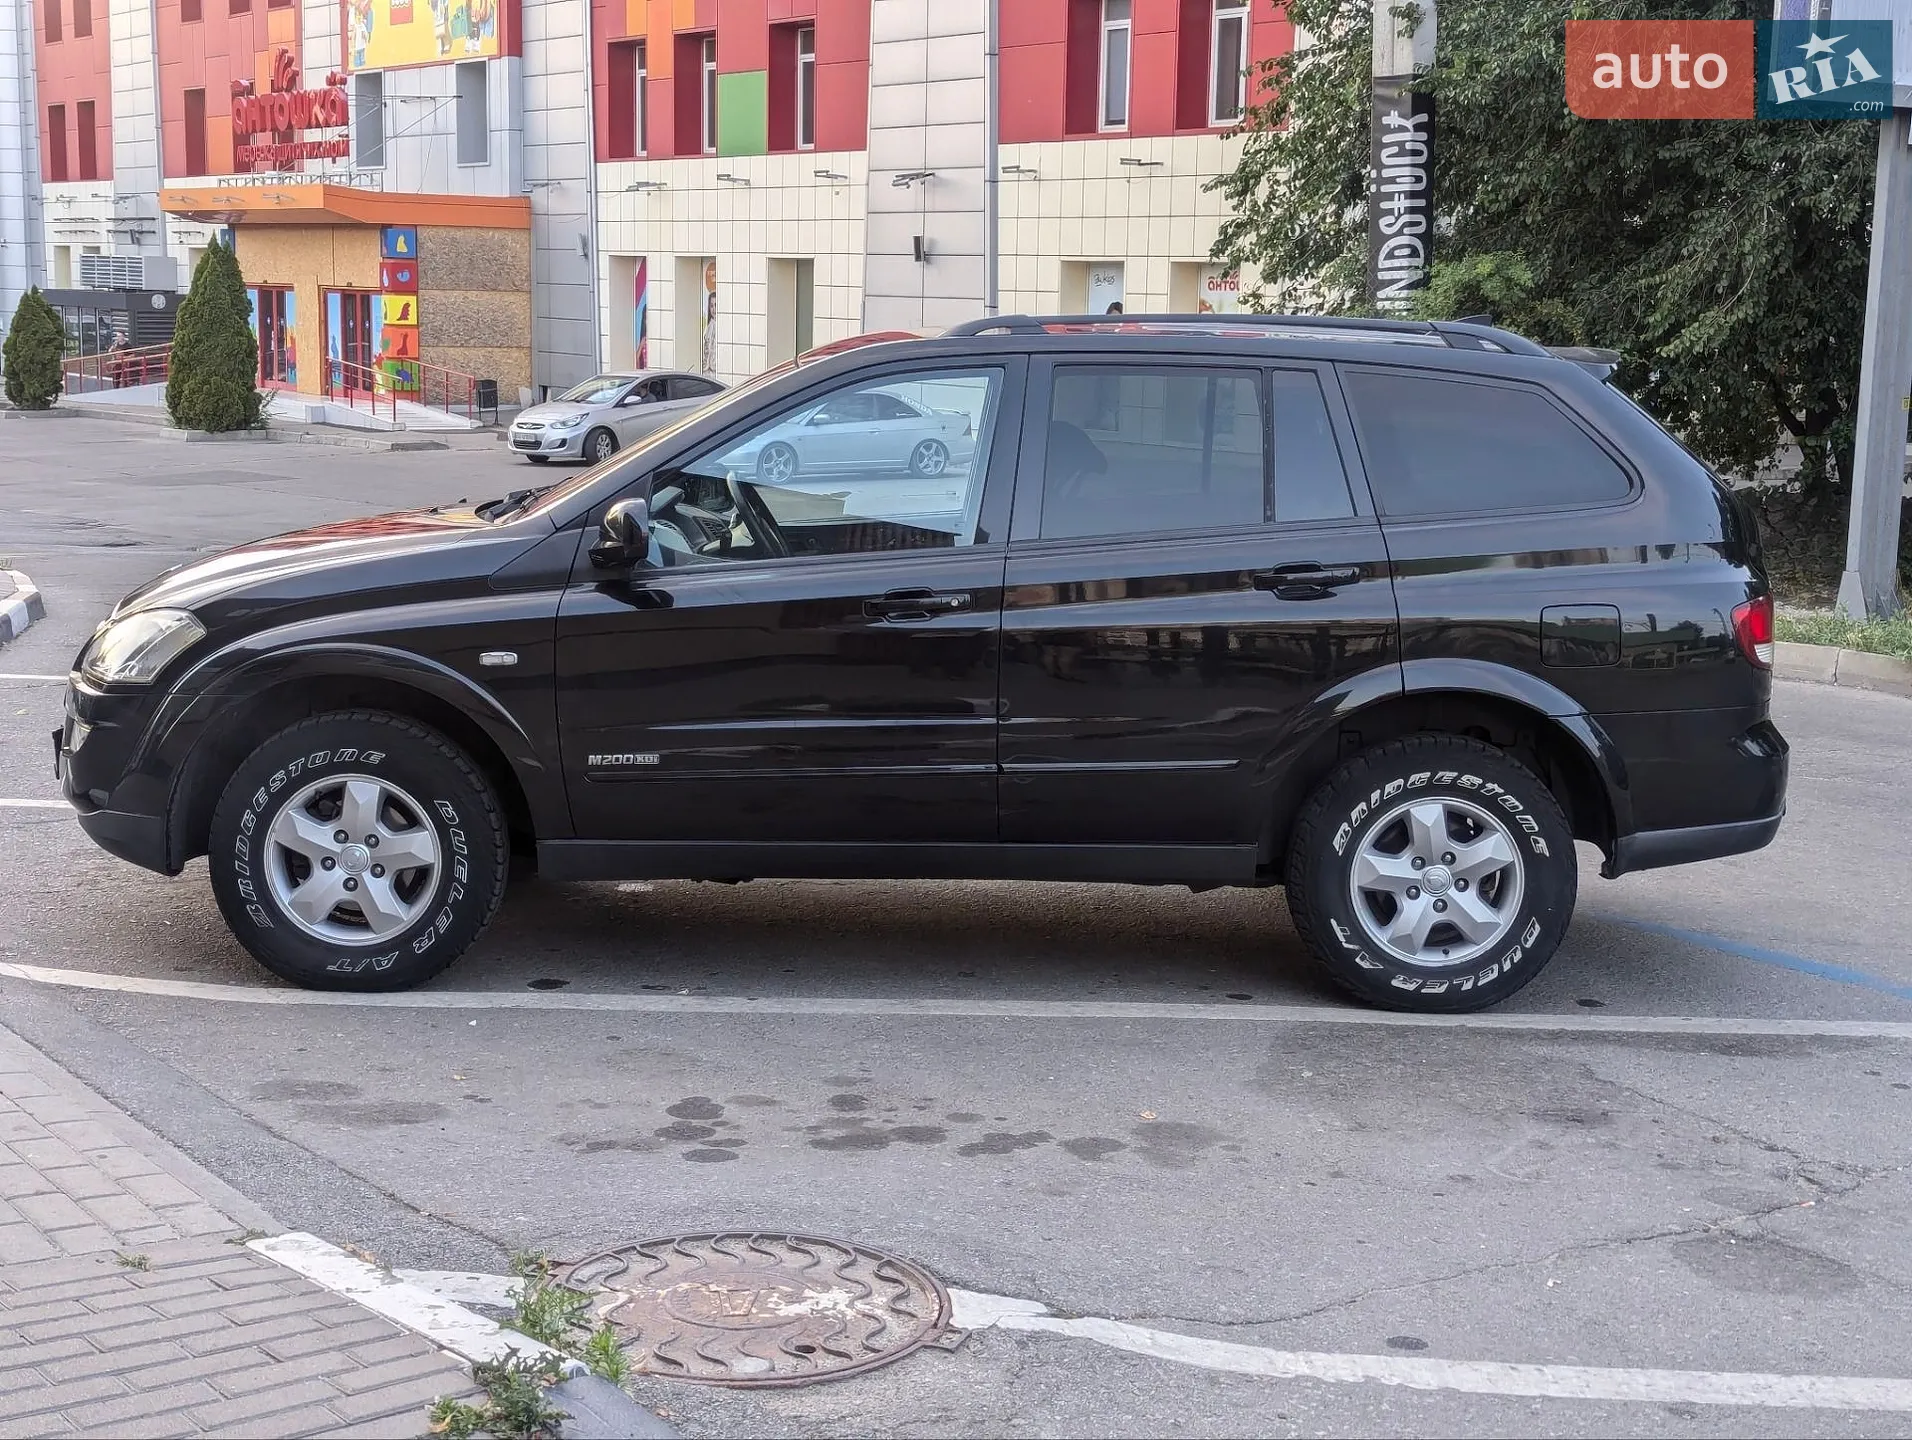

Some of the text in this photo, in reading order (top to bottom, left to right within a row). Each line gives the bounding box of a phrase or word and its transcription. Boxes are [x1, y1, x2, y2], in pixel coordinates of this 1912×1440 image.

[234, 748, 386, 929] BRIDGESTONE
[1332, 771, 1550, 858] BRIDGESTONE
[412, 799, 468, 954] DUELER
[1390, 916, 1541, 994] DUELER
